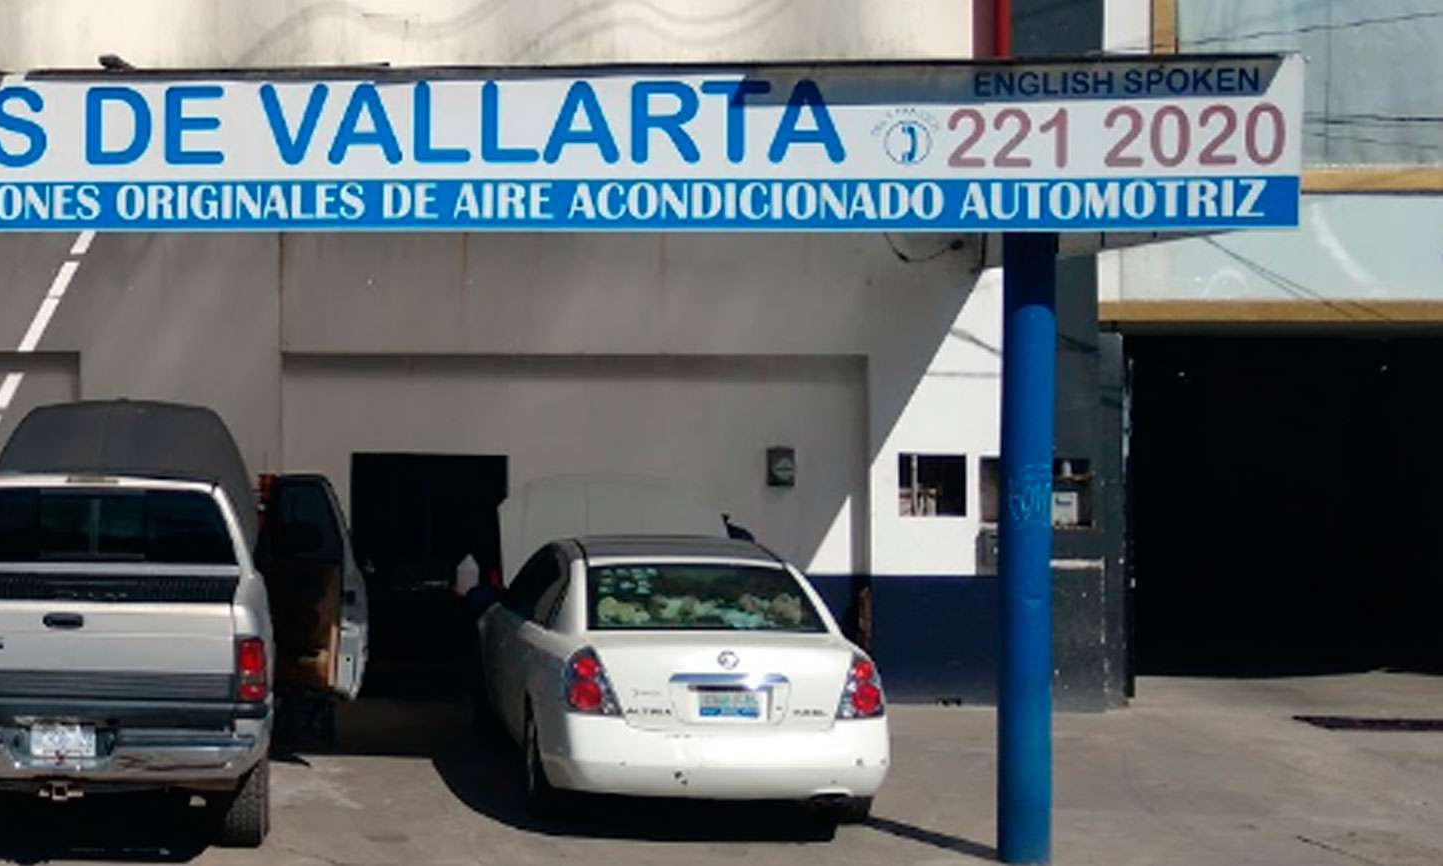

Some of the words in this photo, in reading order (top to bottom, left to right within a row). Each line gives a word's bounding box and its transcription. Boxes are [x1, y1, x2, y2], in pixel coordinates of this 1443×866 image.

[973, 70, 1115, 98] ENGLISH
[1125, 67, 1260, 96] SPOKEN
[85, 84, 225, 167] DE
[259, 80, 846, 166] VALLARTA
[947, 107, 1069, 168] 221
[1103, 102, 1286, 168] 2020
[115, 184, 365, 220] ORIGINALES
[382, 183, 437, 219] DE
[453, 183, 554, 219] AIRE
[567, 182, 944, 220] ACONDICIONADO
[960, 180, 1267, 220] AUTOMOTRIZ
